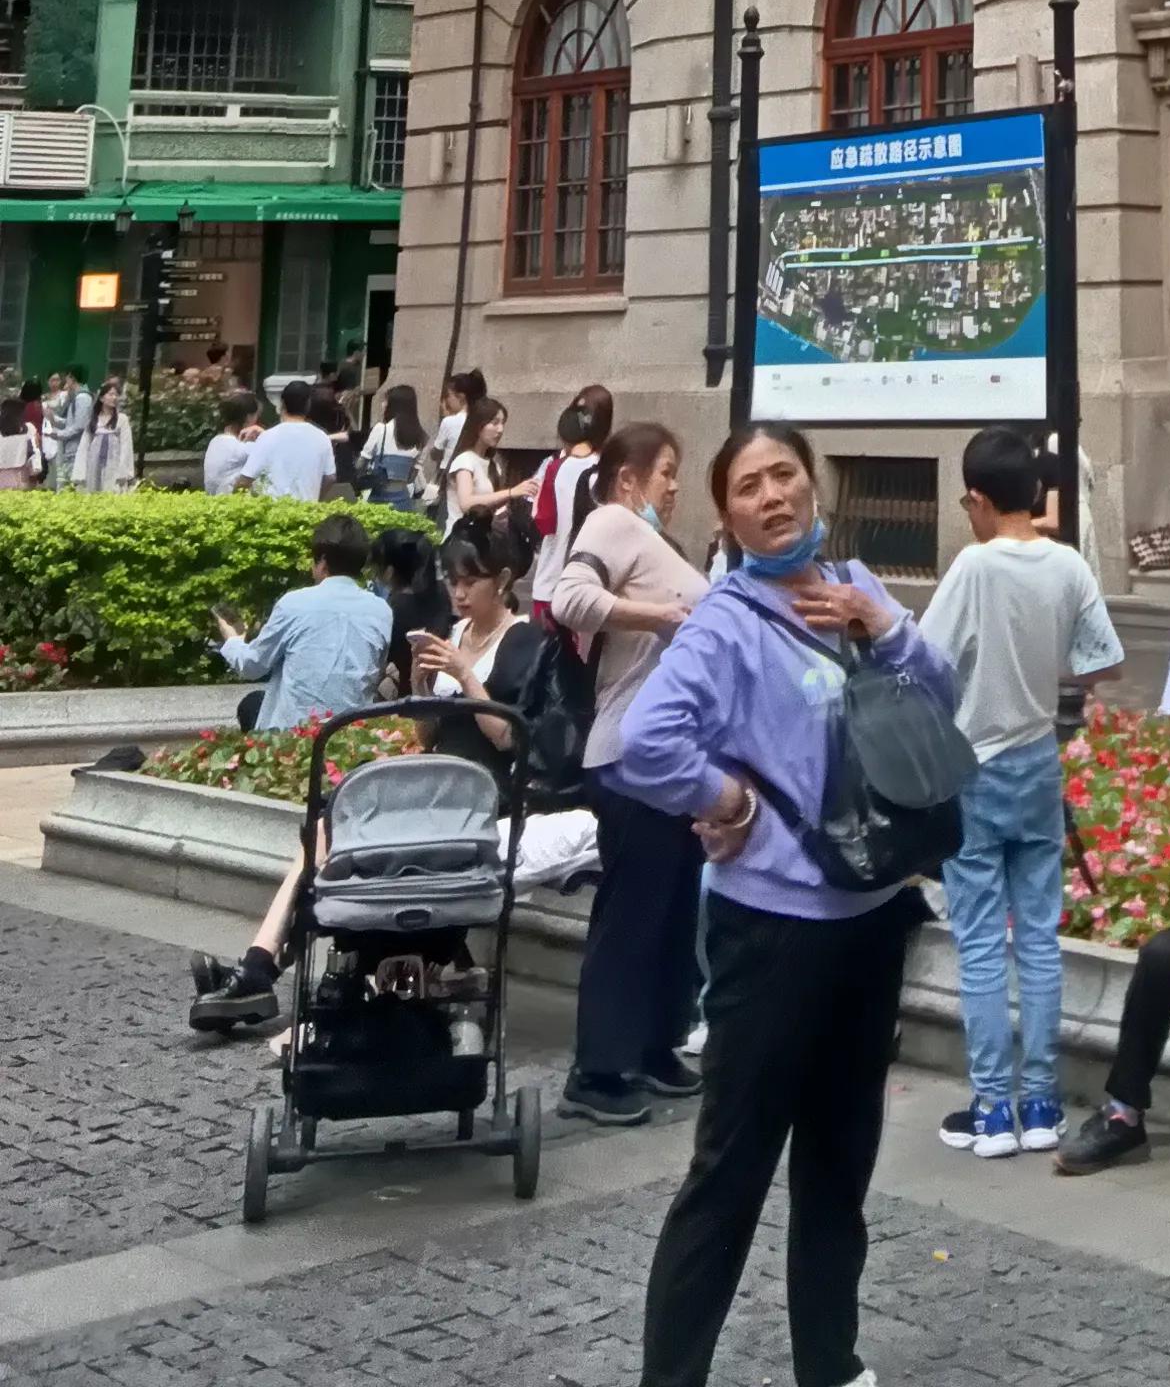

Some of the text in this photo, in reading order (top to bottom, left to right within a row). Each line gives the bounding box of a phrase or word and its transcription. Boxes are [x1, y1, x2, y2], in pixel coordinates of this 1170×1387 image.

[830, 133, 962, 170] 应急疏散路径示意图
